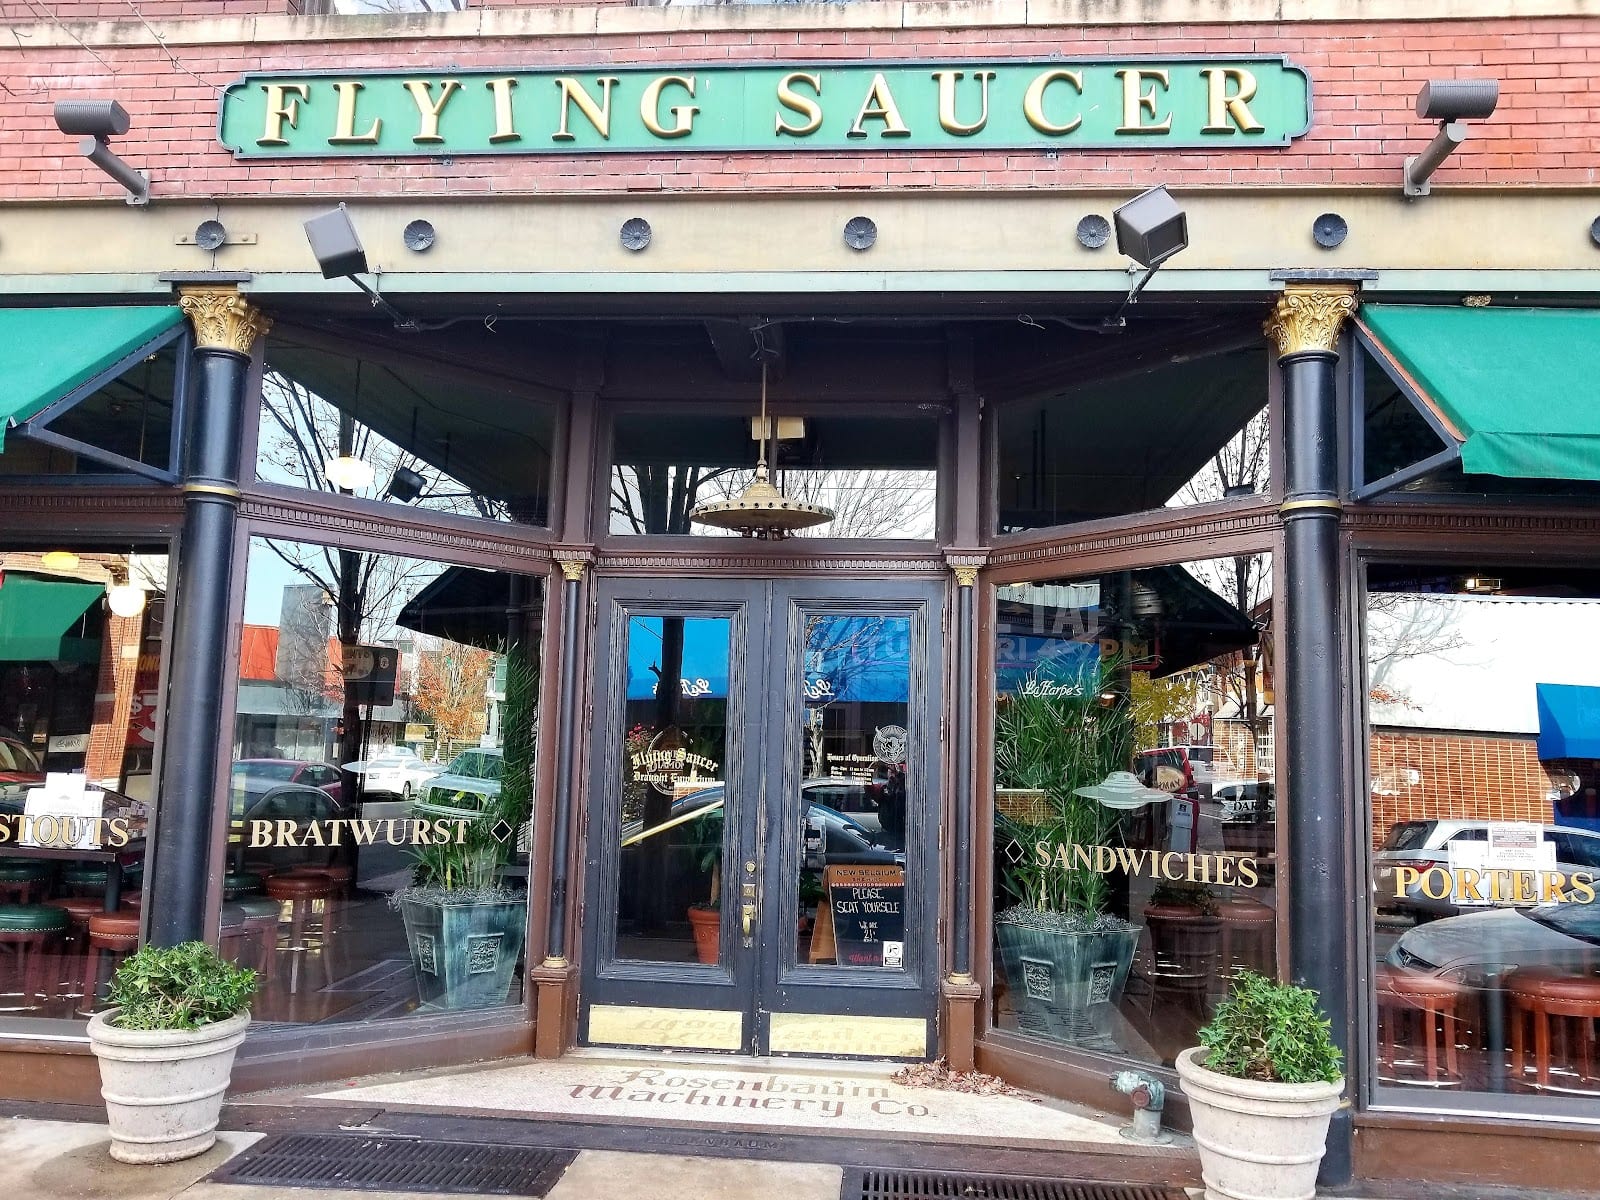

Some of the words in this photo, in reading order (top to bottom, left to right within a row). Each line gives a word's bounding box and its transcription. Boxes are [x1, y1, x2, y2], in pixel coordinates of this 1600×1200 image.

[256, 75, 700, 145] FLYING
[774, 67, 1265, 138] SAUCER
[631, 751, 672, 771] Flying
[676, 748, 719, 772] Saucer
[633, 771, 668, 784] Draught
[0, 814, 129, 847] STOUTS
[248, 818, 471, 848] BRATWURST
[1035, 841, 1259, 888] SANDWICHES
[852, 888, 884, 899] PLEASE
[1393, 866, 1596, 904] PORTERS
[836, 901, 858, 913] SEAT
[611, 1069, 889, 1098] Rosenbaum
